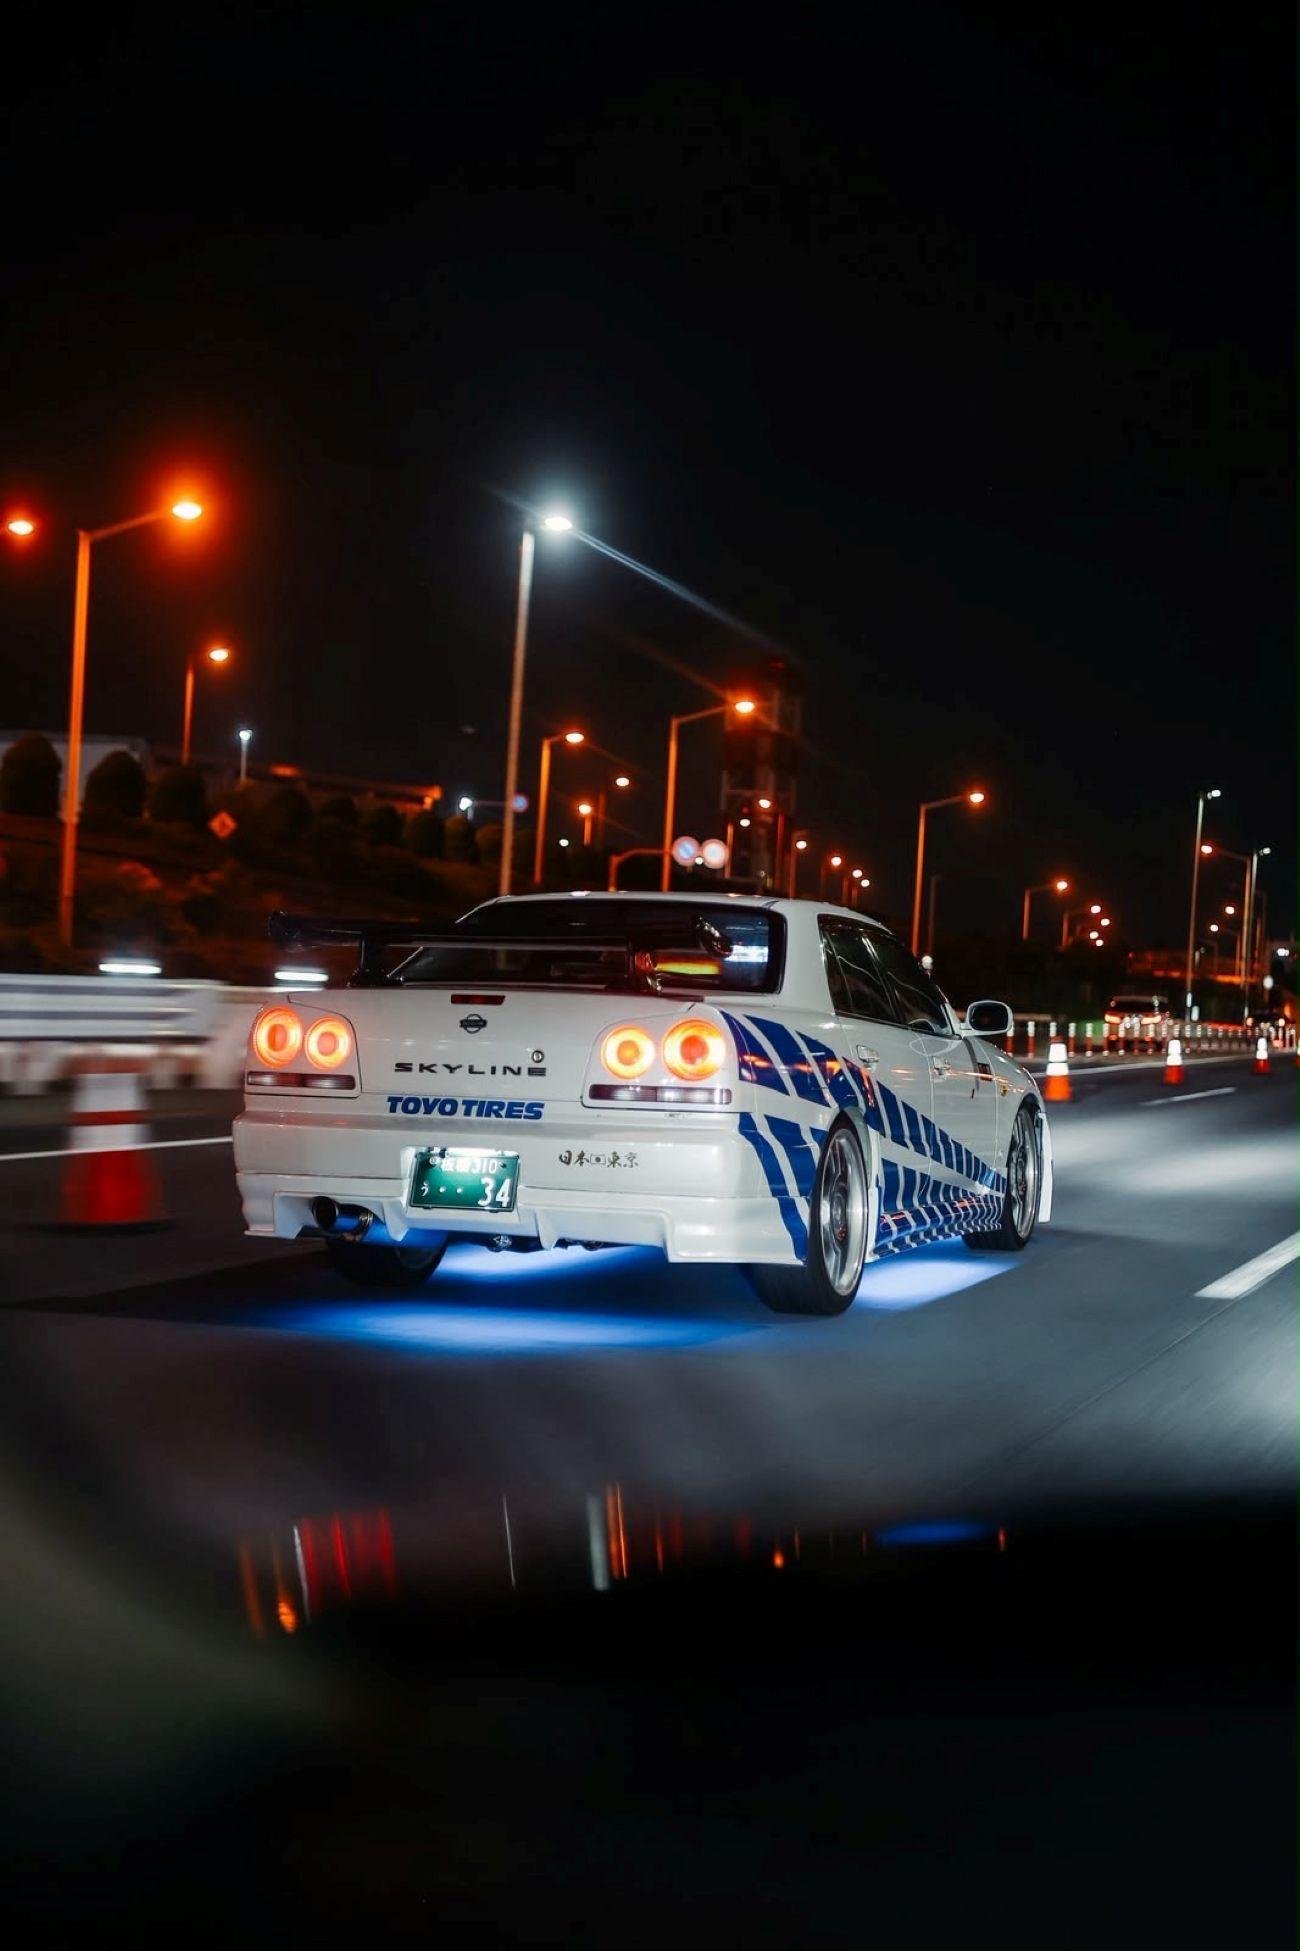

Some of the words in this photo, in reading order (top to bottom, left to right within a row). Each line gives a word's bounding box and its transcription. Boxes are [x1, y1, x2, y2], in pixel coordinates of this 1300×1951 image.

[394, 1062, 547, 1077] SKYLINE
[387, 1096, 459, 1117] TOYO
[461, 1100, 545, 1120] TIRES
[558, 1150, 589, 1167] 日本
[478, 1177, 511, 1207] 34
